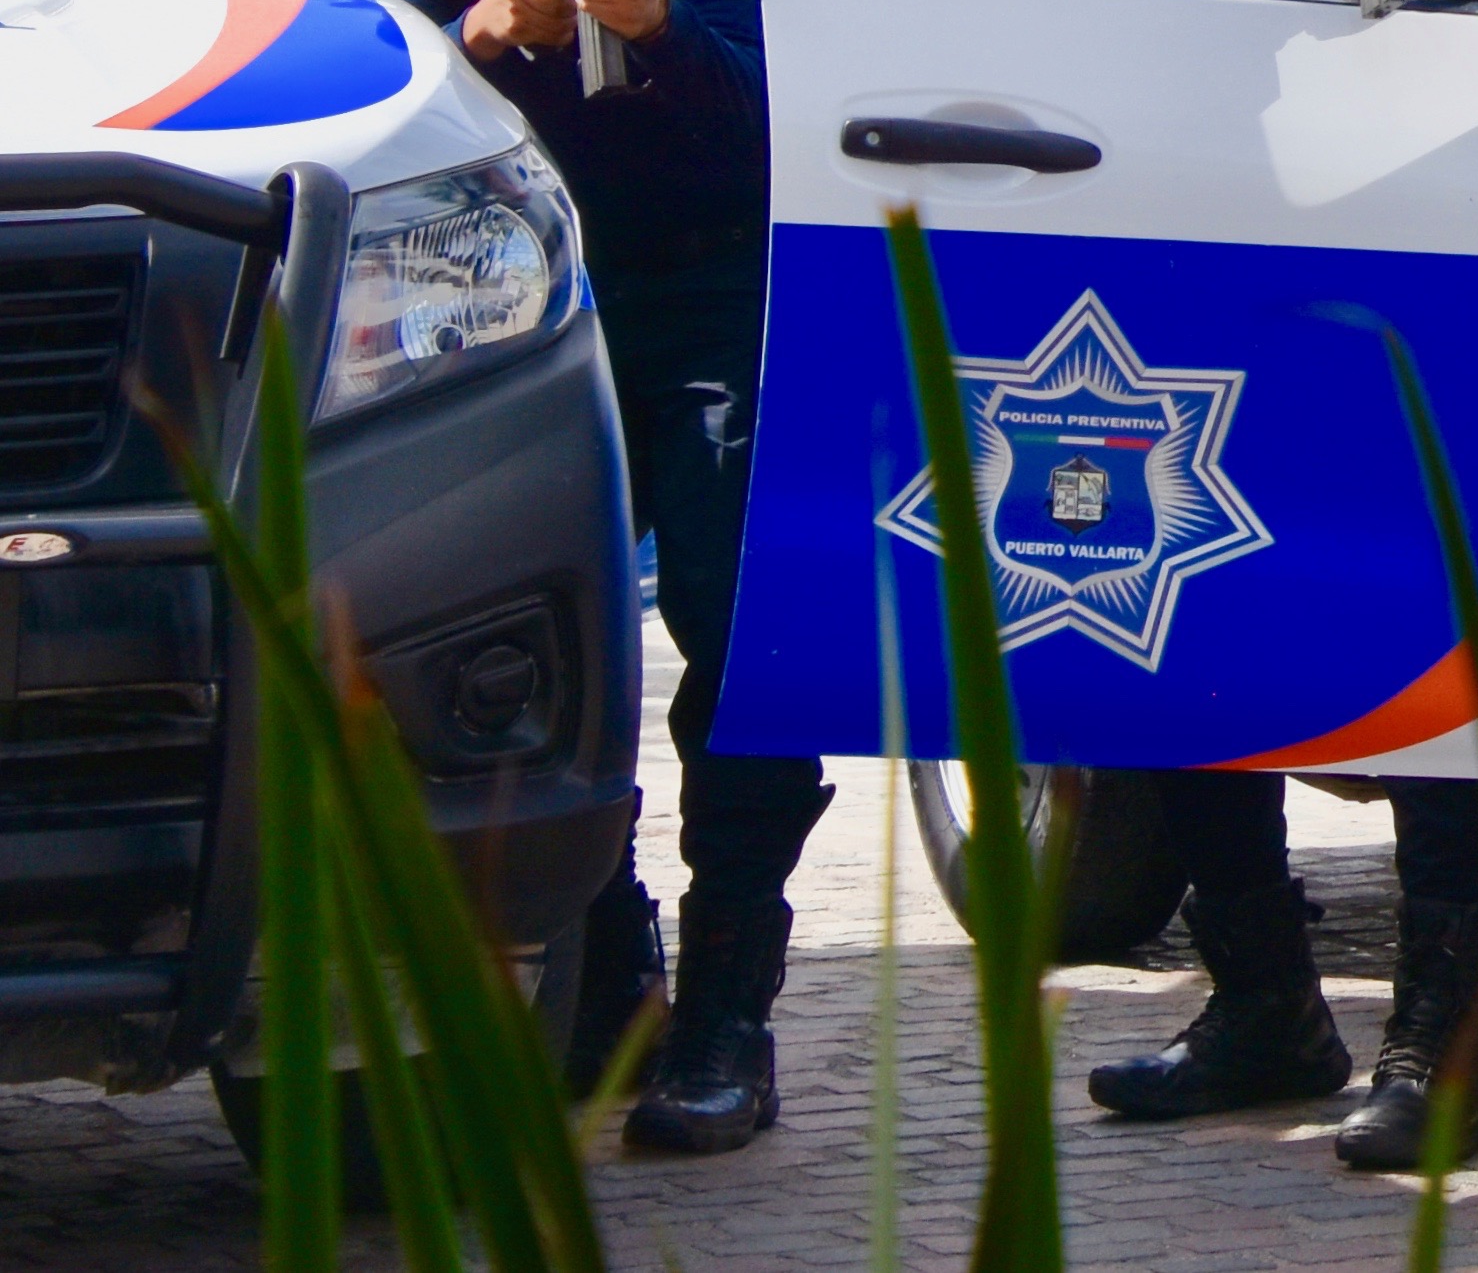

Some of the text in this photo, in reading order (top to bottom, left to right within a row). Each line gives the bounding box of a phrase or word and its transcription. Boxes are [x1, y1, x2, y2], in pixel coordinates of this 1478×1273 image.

[999, 411, 1166, 431] POLICIA PREVENTIVA
[1004, 541, 1145, 561] PUERTO VALLARTA
